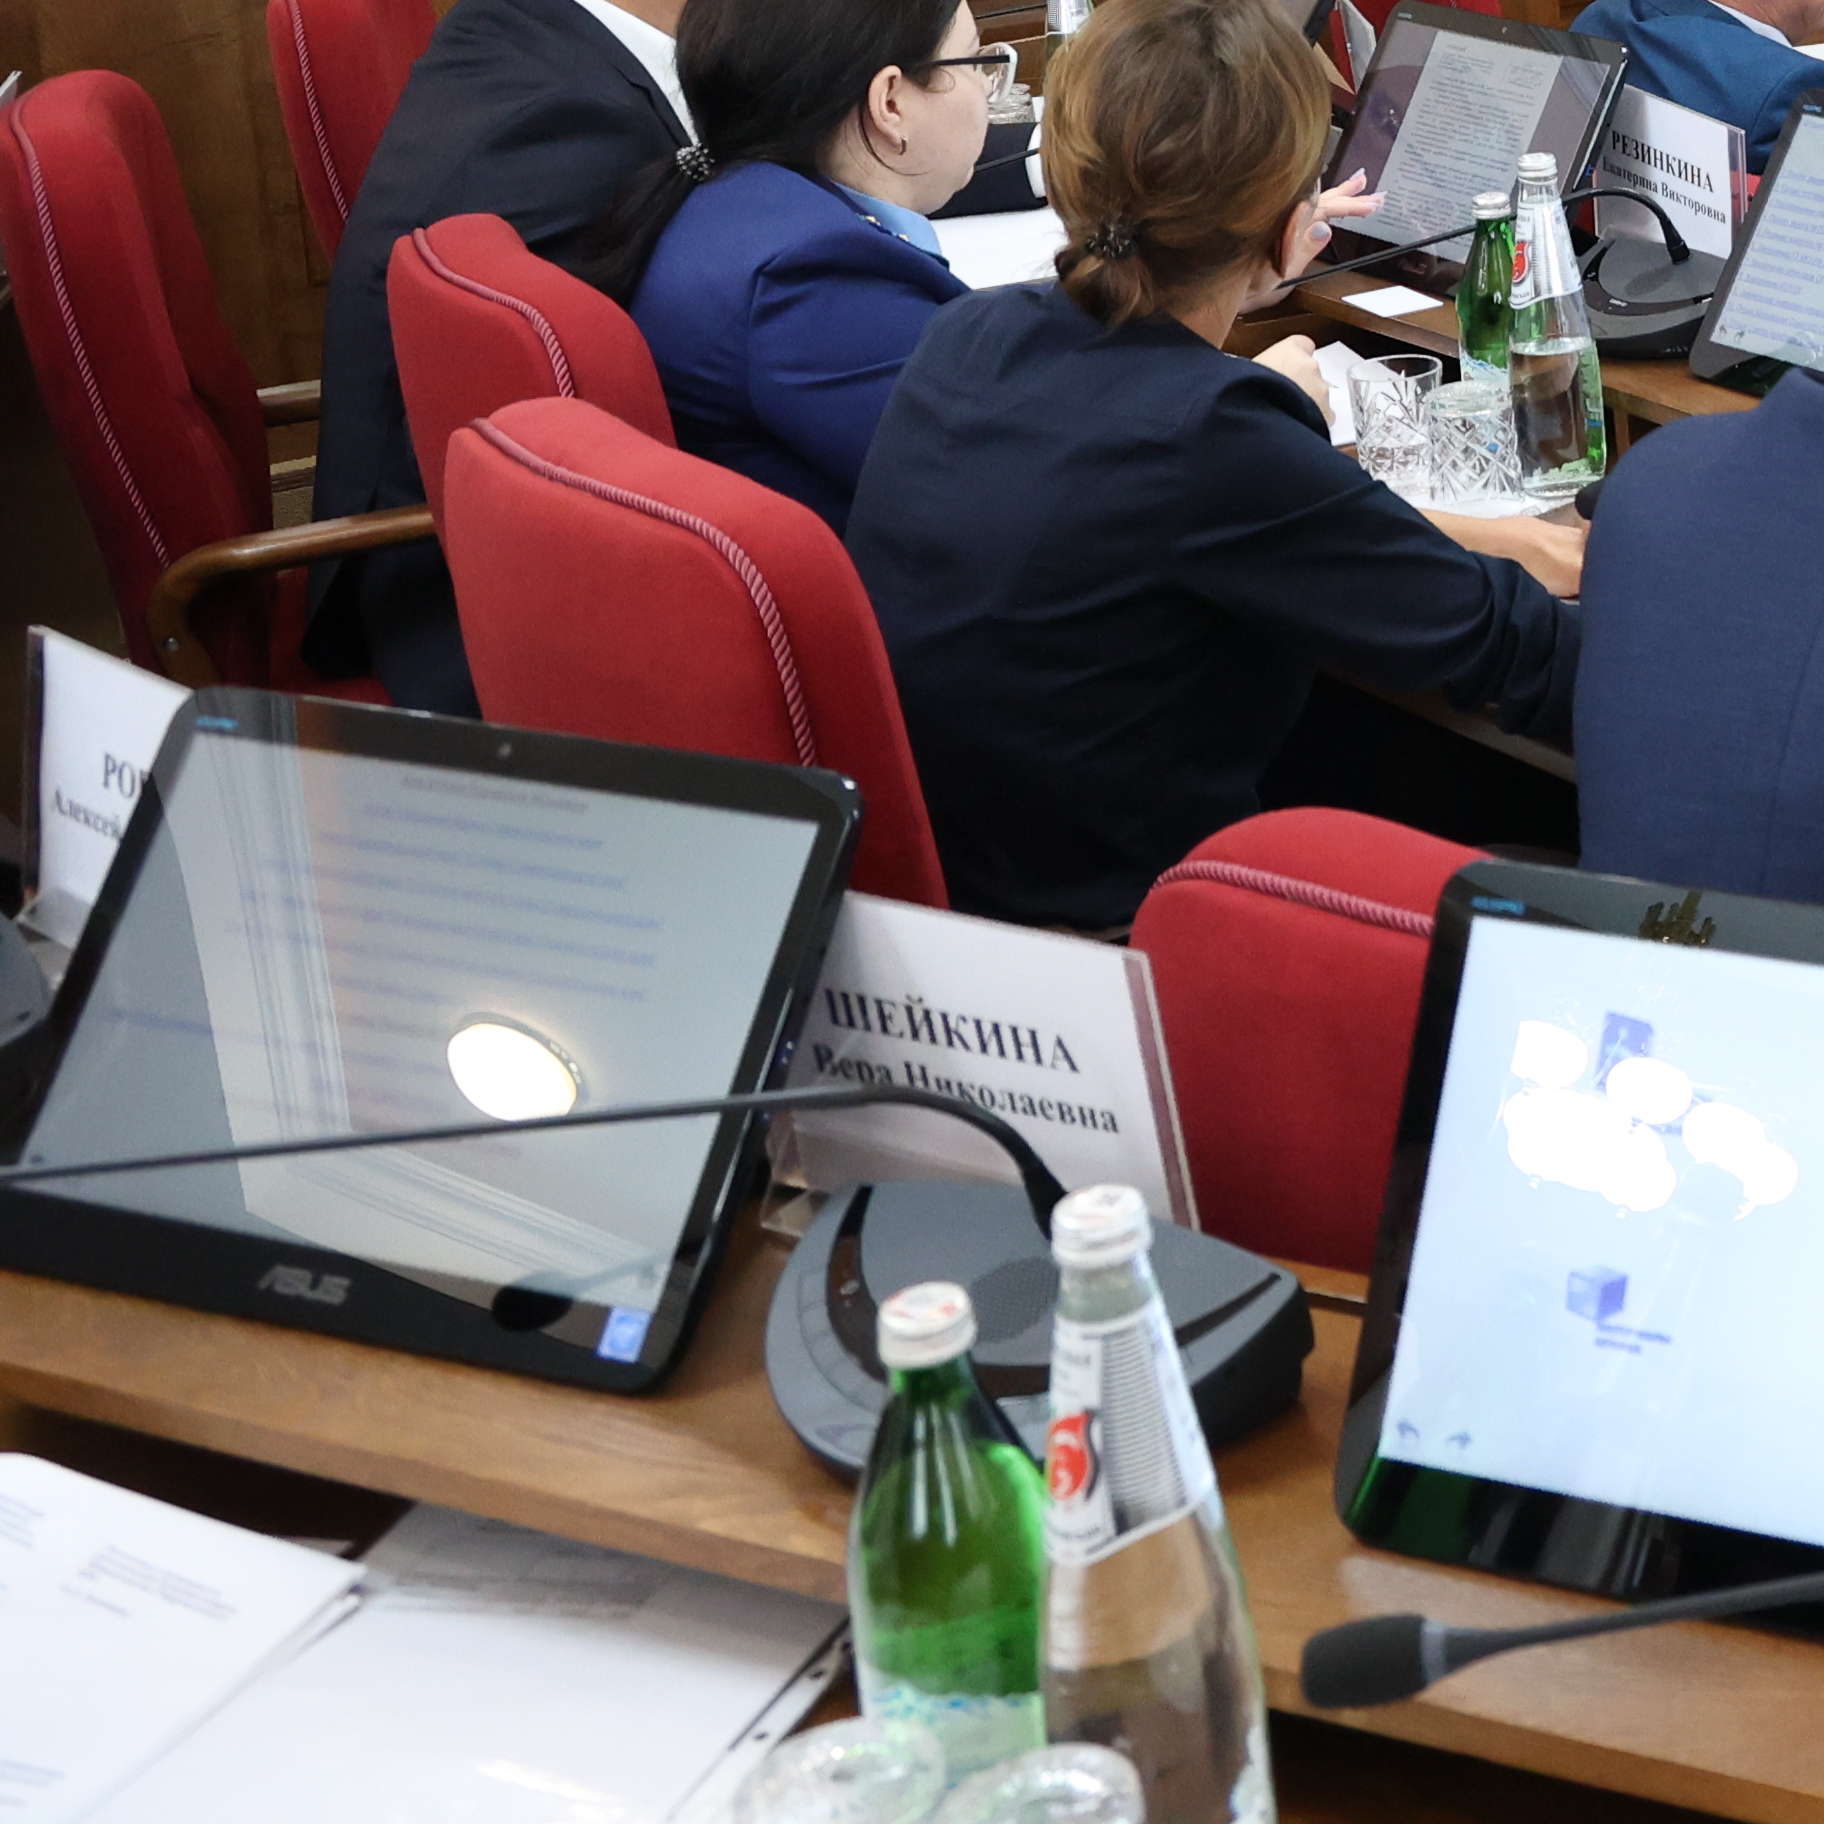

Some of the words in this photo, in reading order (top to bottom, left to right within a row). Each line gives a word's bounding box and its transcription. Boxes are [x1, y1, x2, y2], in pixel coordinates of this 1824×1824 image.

[1602, 156, 1659, 194] Екатерина
[1661, 180, 1726, 224] Викторовна
[1612, 130, 1714, 193] РЕЗИНКИНА
[824, 988, 1080, 1073] ШЕЙКИНА
[813, 1043, 893, 1086] Вера
[903, 1059, 1119, 1134] Николаевна
[257, 1264, 352, 1305] ASUS
